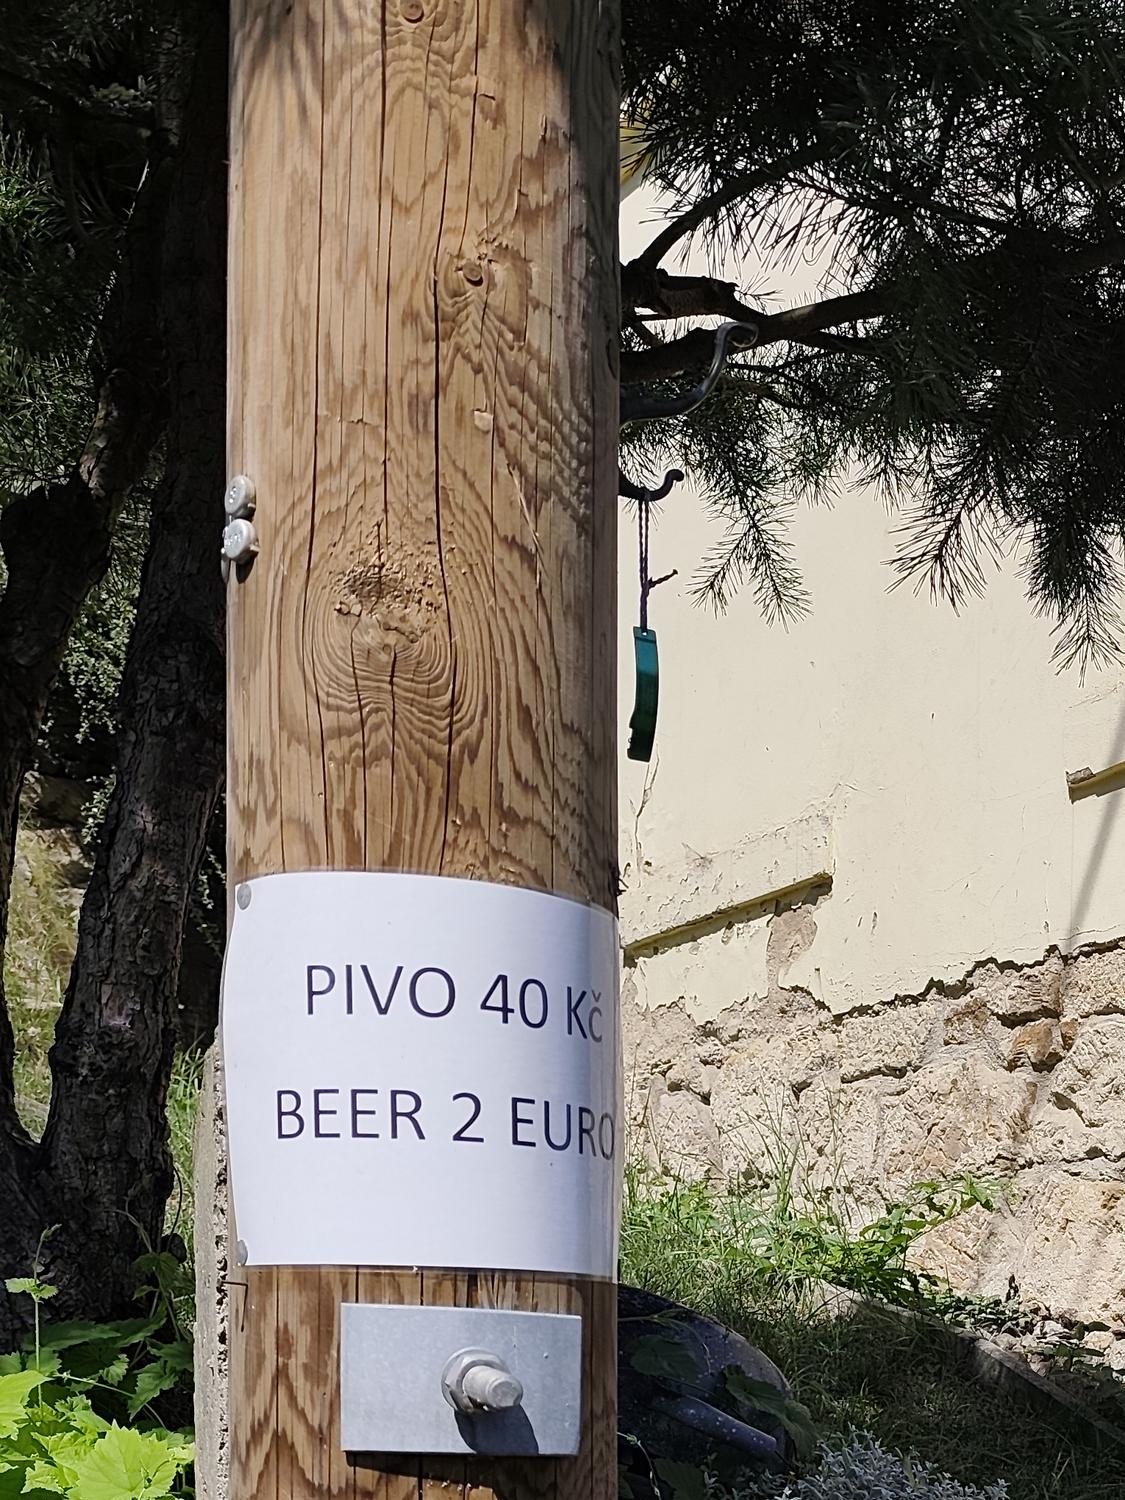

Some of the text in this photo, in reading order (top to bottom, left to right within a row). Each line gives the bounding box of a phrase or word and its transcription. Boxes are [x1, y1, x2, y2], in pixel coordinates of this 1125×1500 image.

[305, 963, 603, 1044] PIVO 40 Kč
[275, 1088, 616, 1162] BEER 2 EURO
